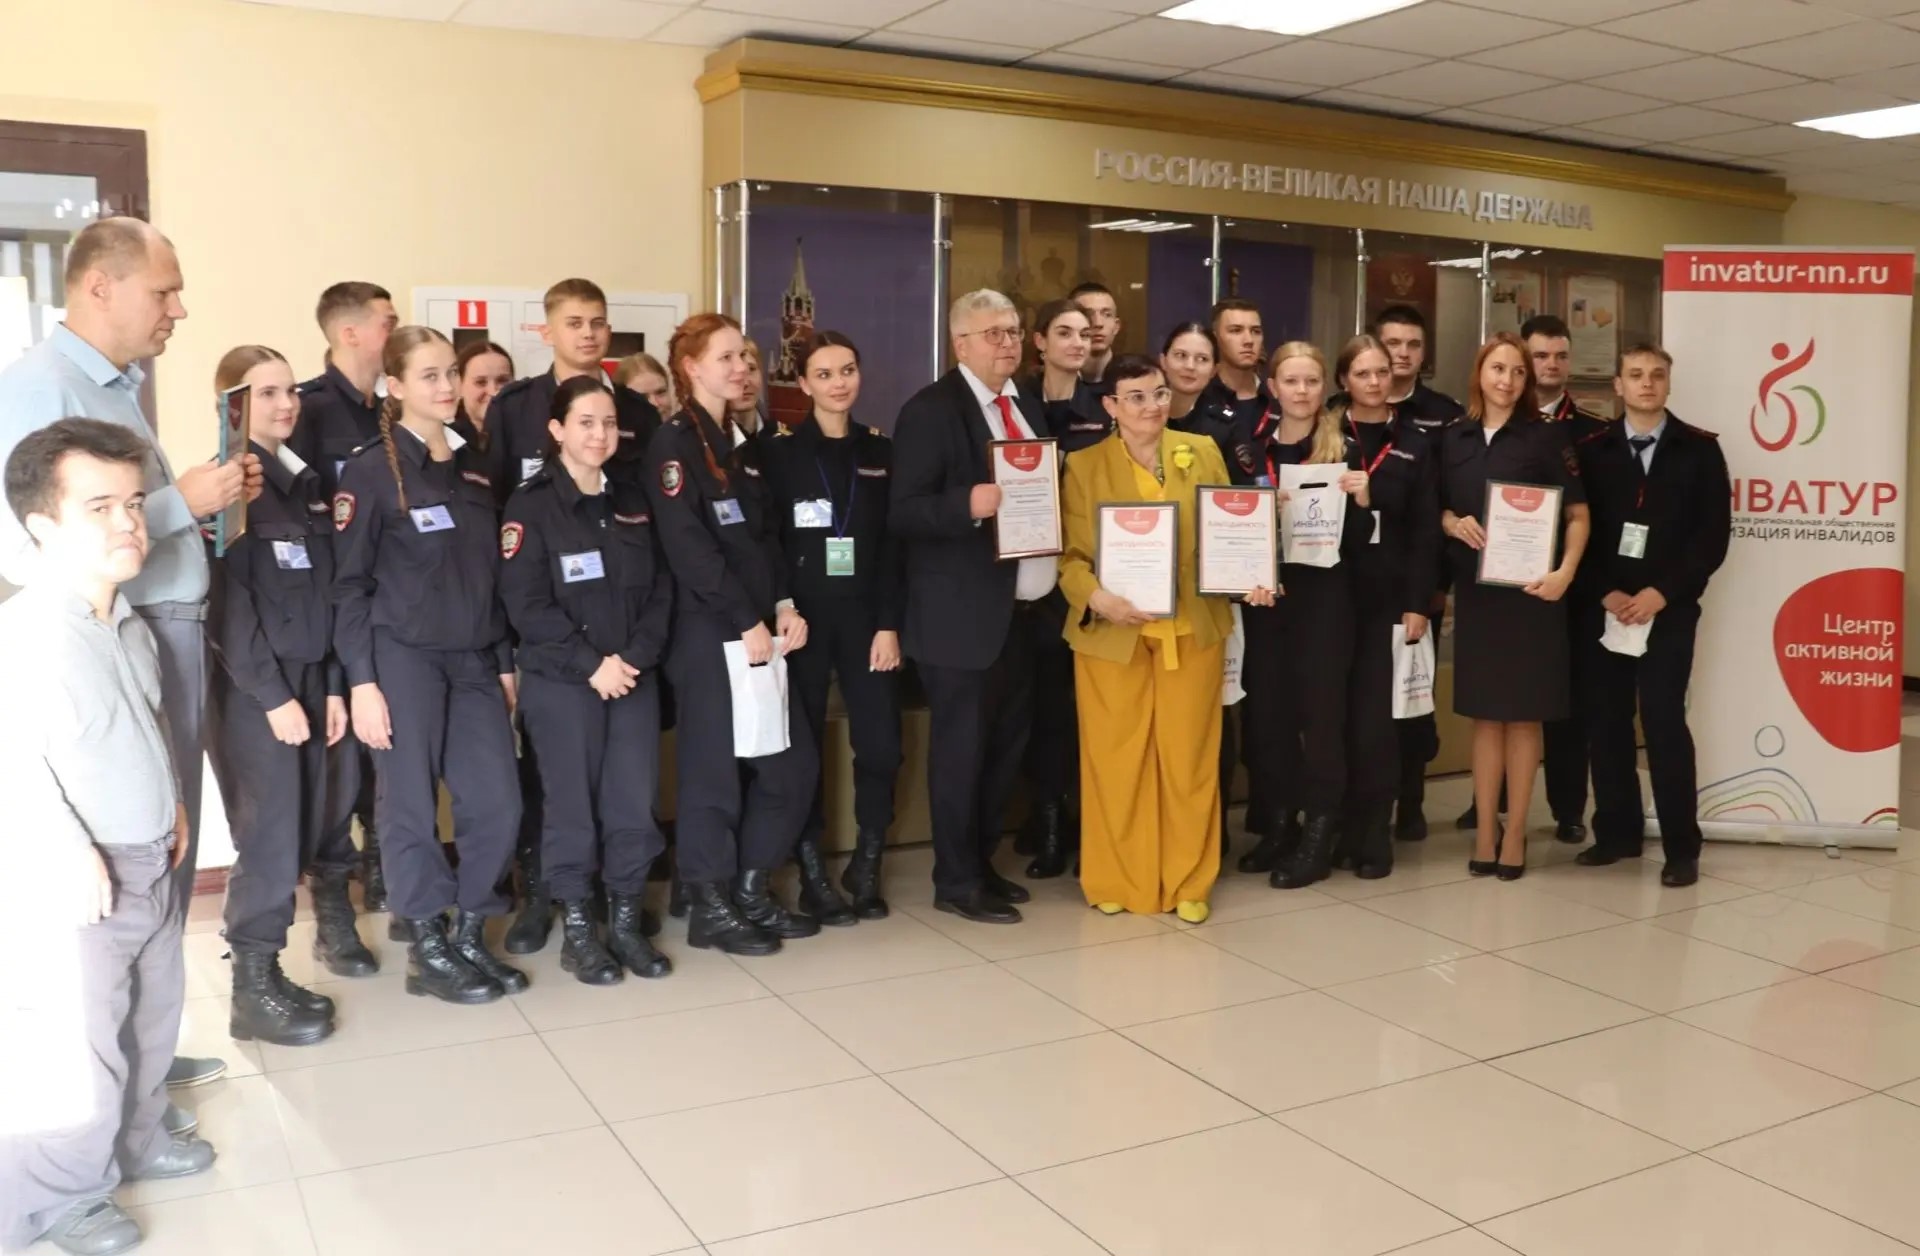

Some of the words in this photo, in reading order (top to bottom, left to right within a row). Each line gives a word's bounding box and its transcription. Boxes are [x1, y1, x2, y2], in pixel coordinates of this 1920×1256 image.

[1388, 178, 1472, 216] НАША
[1474, 190, 1594, 231] ДЕРЖАВА
[1689, 256, 1889, 285] invatur-nn.ru
[1795, 528, 1896, 545] ИНВАЛИДОВ
[1823, 613, 1896, 641] Центр
[1784, 640, 1894, 662] активной
[1819, 669, 1893, 688] жизни
